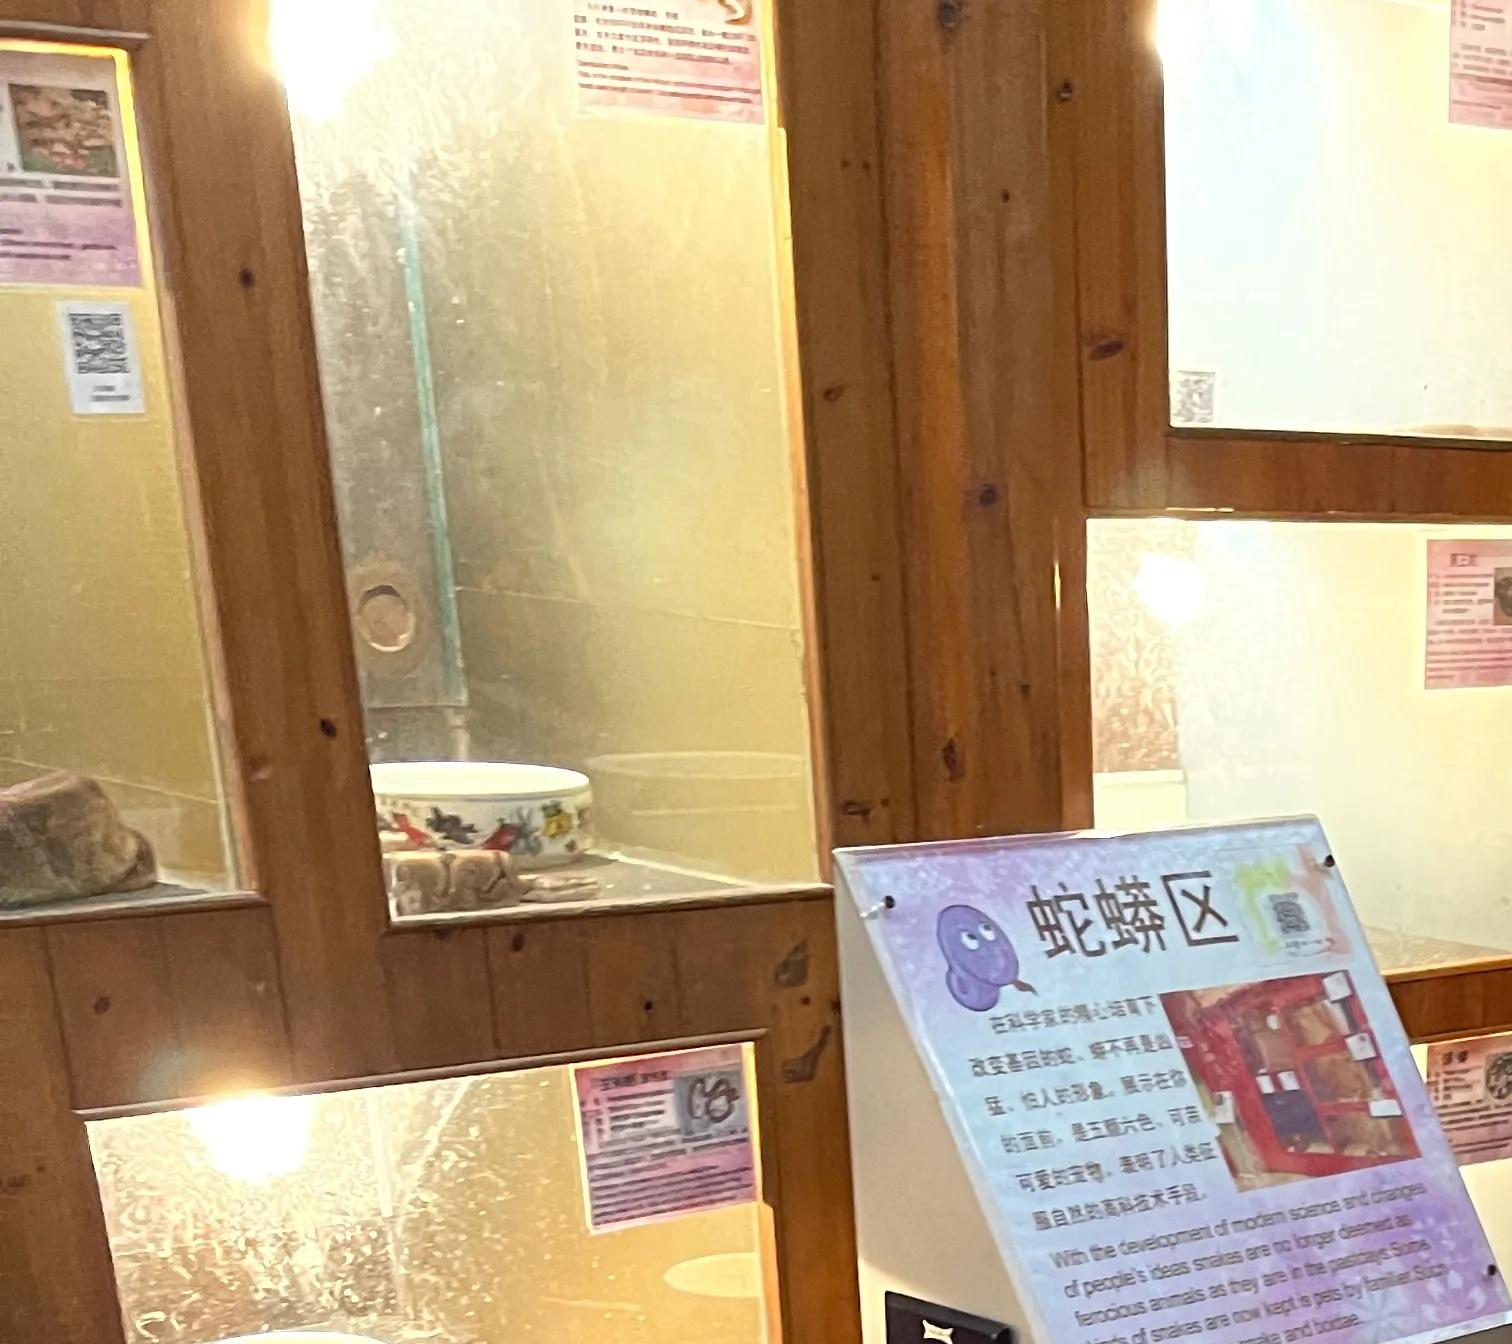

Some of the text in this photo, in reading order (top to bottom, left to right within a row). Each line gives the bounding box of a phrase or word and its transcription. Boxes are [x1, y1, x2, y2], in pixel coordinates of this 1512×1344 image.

[1027, 871, 1239, 958] 蛇蟒区
[1051, 1182, 1427, 1268] With the development of modern science and changes
[1064, 1213, 1413, 1299] of people's ideas snakes are no longer deemed as
[1075, 1301, 1148, 1327] ferocious
[1149, 1287, 1206, 1312] animals
[1207, 1283, 1228, 1299] as
[1227, 1275, 1259, 1294] they
[1262, 1271, 1288, 1287] are
[1303, 1260, 1326, 1277] the
[1151, 1320, 1202, 1343] snakes
[1205, 1314, 1231, 1331] are
[1232, 1307, 1261, 1323] now
[1263, 1297, 1297, 1317] kept
[1313, 1286, 1343, 1307] pets
[1343, 1279, 1363, 1300] by
[1283, 1322, 1313, 1344] and
